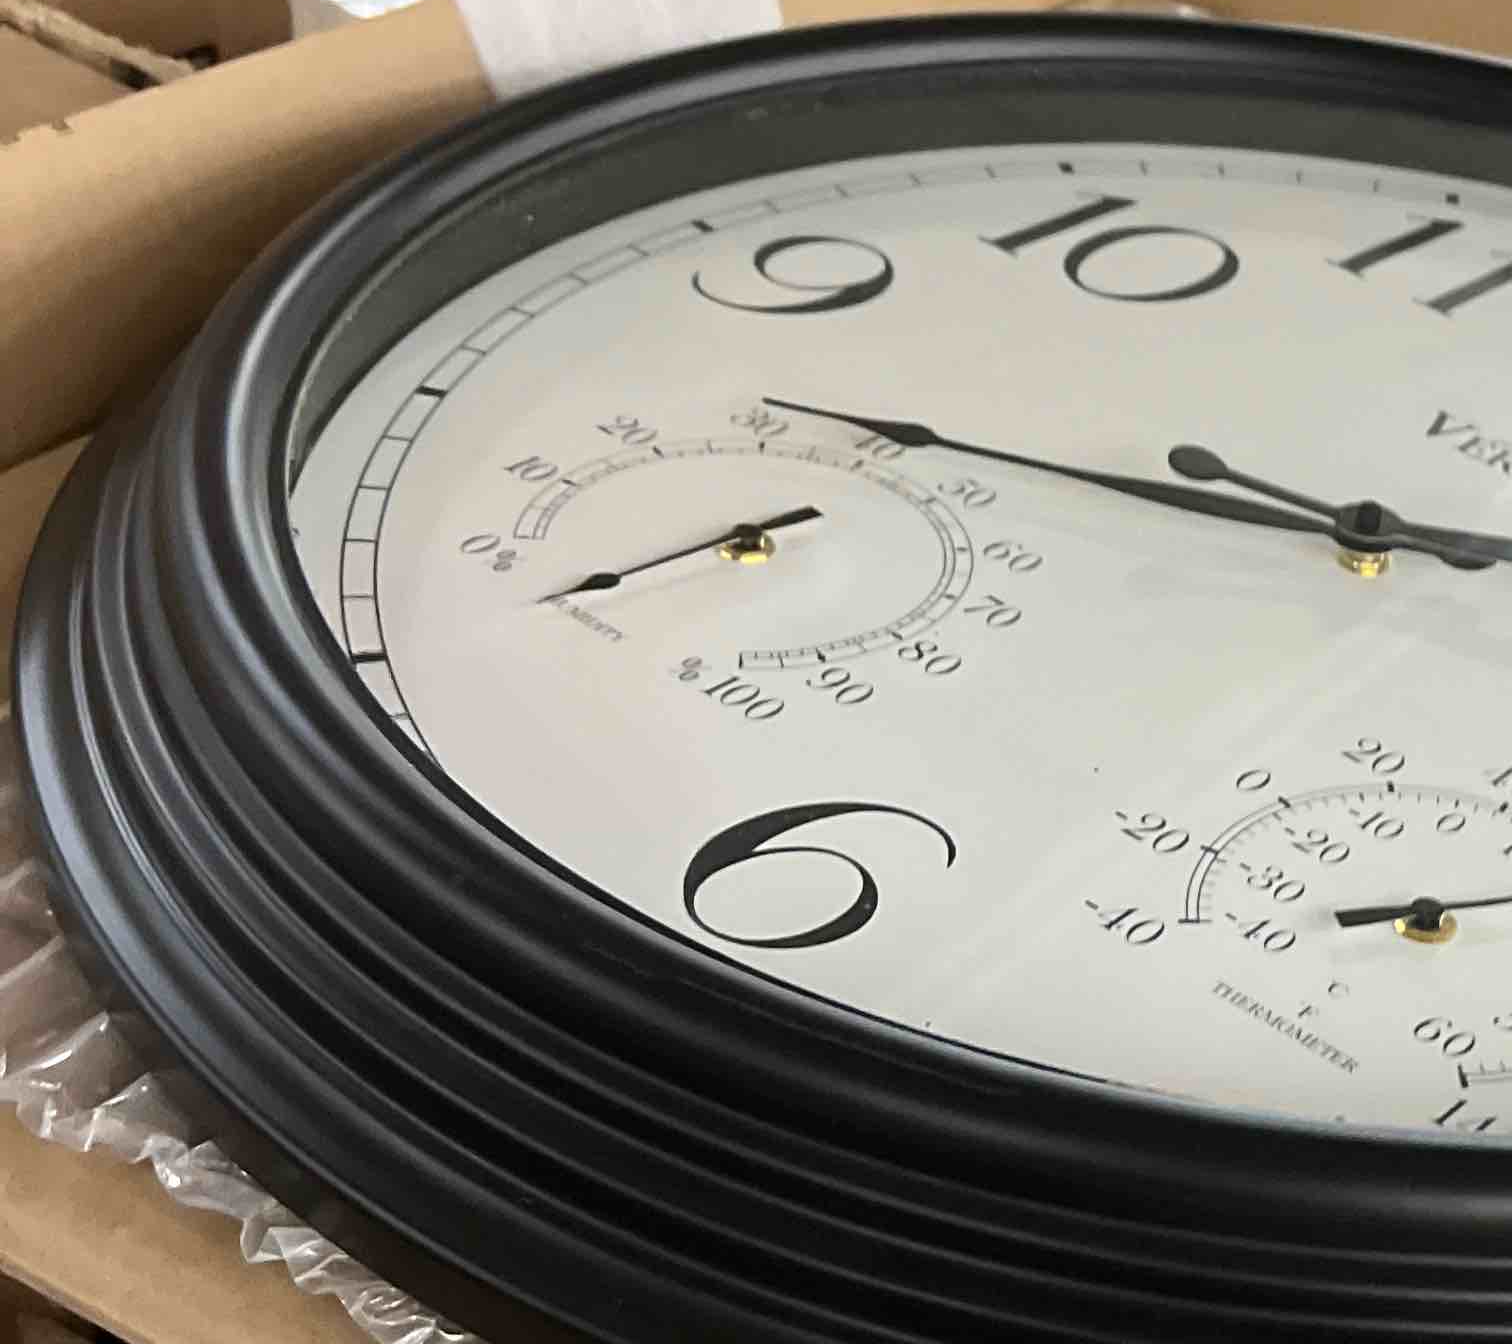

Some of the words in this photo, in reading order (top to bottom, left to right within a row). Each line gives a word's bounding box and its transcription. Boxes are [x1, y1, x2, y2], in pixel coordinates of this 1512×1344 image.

[978, 192, 1240, 302] 10
[692, 235, 893, 314] 9
[597, 415, 657, 446] 20
[502, 455, 558, 482] 10
[937, 476, 998, 509] 50
[982, 539, 1044, 573] 60
[963, 593, 1022, 629] 70
[896, 638, 963, 677] 80
[804, 665, 875, 706] 90
[1341, 735, 1405, 775] 20
[1235, 768, 1272, 793] 0
[1114, 810, 1190, 854] -20
[1348, 808, 1405, 840] -10
[1435, 811, 1467, 835] 0
[1284, 826, 1350, 864] -20
[683, 802, 956, 948] 6
[1240, 862, 1306, 903] -30
[1084, 898, 1166, 946] -40
[1211, 978, 1361, 1076] THERMOMETER
[1412, 1015, 1477, 1058] 60
